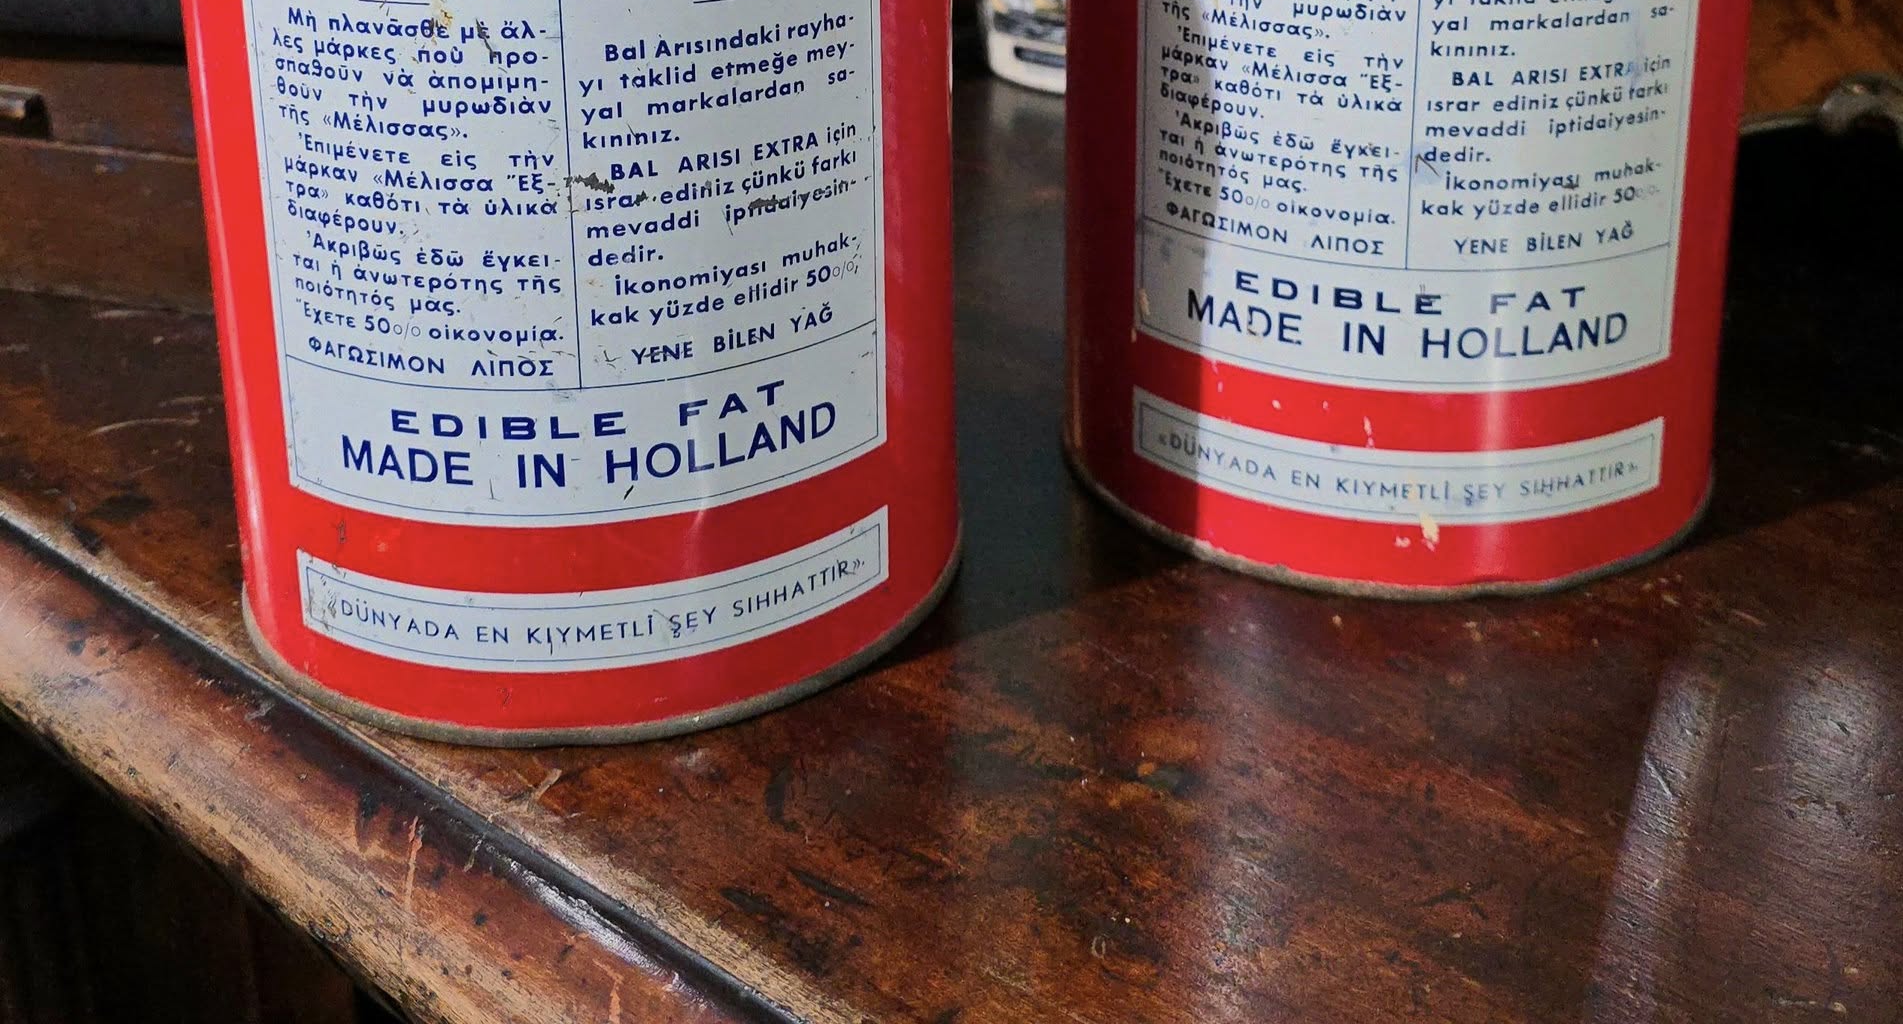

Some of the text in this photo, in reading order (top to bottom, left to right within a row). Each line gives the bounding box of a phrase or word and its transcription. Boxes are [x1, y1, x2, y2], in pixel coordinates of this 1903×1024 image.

[1432, 5, 1674, 34] yal markalardan sa-
[272, 28, 304, 53] λες
[314, 36, 397, 65] μάρκες
[488, 50, 549, 70] προ-
[605, 13, 854, 61] Bal Arısındaki rayha-
[1431, 41, 1516, 57] kınınız.
[579, 42, 855, 97] yı taklid etmeğe mey-
[1452, 72, 1494, 86] BAL
[1512, 68, 1567, 86] ARISI
[581, 68, 855, 125] yal markalardan sa-
[1427, 86, 1622, 112] ısrar ediniz çünkü
[583, 128, 680, 149] kınınız.
[1159, 128, 1184, 146] ται
[1426, 119, 1526, 137] mevaddi
[611, 122, 856, 180] BAL ARISI EXTRA için
[1423, 147, 1491, 162] dedir.
[286, 180, 328, 202] τρα»
[660, 150, 857, 204] ediniz çünkü farkı
[1263, 176, 1307, 194] μας.
[1446, 159, 1662, 192] İkonomiyası muhak-
[1422, 193, 1607, 220] kak yüzde ellidir
[587, 210, 700, 239] mevaddi
[1166, 201, 1384, 255] ΦΑΓΩΣΙΜΟΝ ΛΙΠΟΣ
[1454, 220, 1634, 254] YENE BİLEN YAĞ
[293, 253, 320, 272] ται
[588, 245, 664, 266] dedir.
[615, 233, 857, 295] İkonomiyası muhak-
[410, 296, 461, 316] μας.
[591, 277, 799, 327] kak yüzde ellidir
[1235, 270, 1585, 315] EDIBLE FAT
[632, 302, 833, 365] YENE BİLEN YAĞ
[1188, 288, 1627, 358] MADE IN HOLLAND
[308, 336, 554, 376] ΦΑΓΩΣΙΜΟΝ ΛΙΠΟΣ
[391, 380, 785, 440] EDIBLE FAT
[342, 401, 837, 488] MADE IN HOLLAND
[1292, 470, 1320, 489] EN
[477, 626, 508, 643] EN
[527, 614, 653, 644] KIYMETLİ
[669, 606, 716, 638] ŞEY
